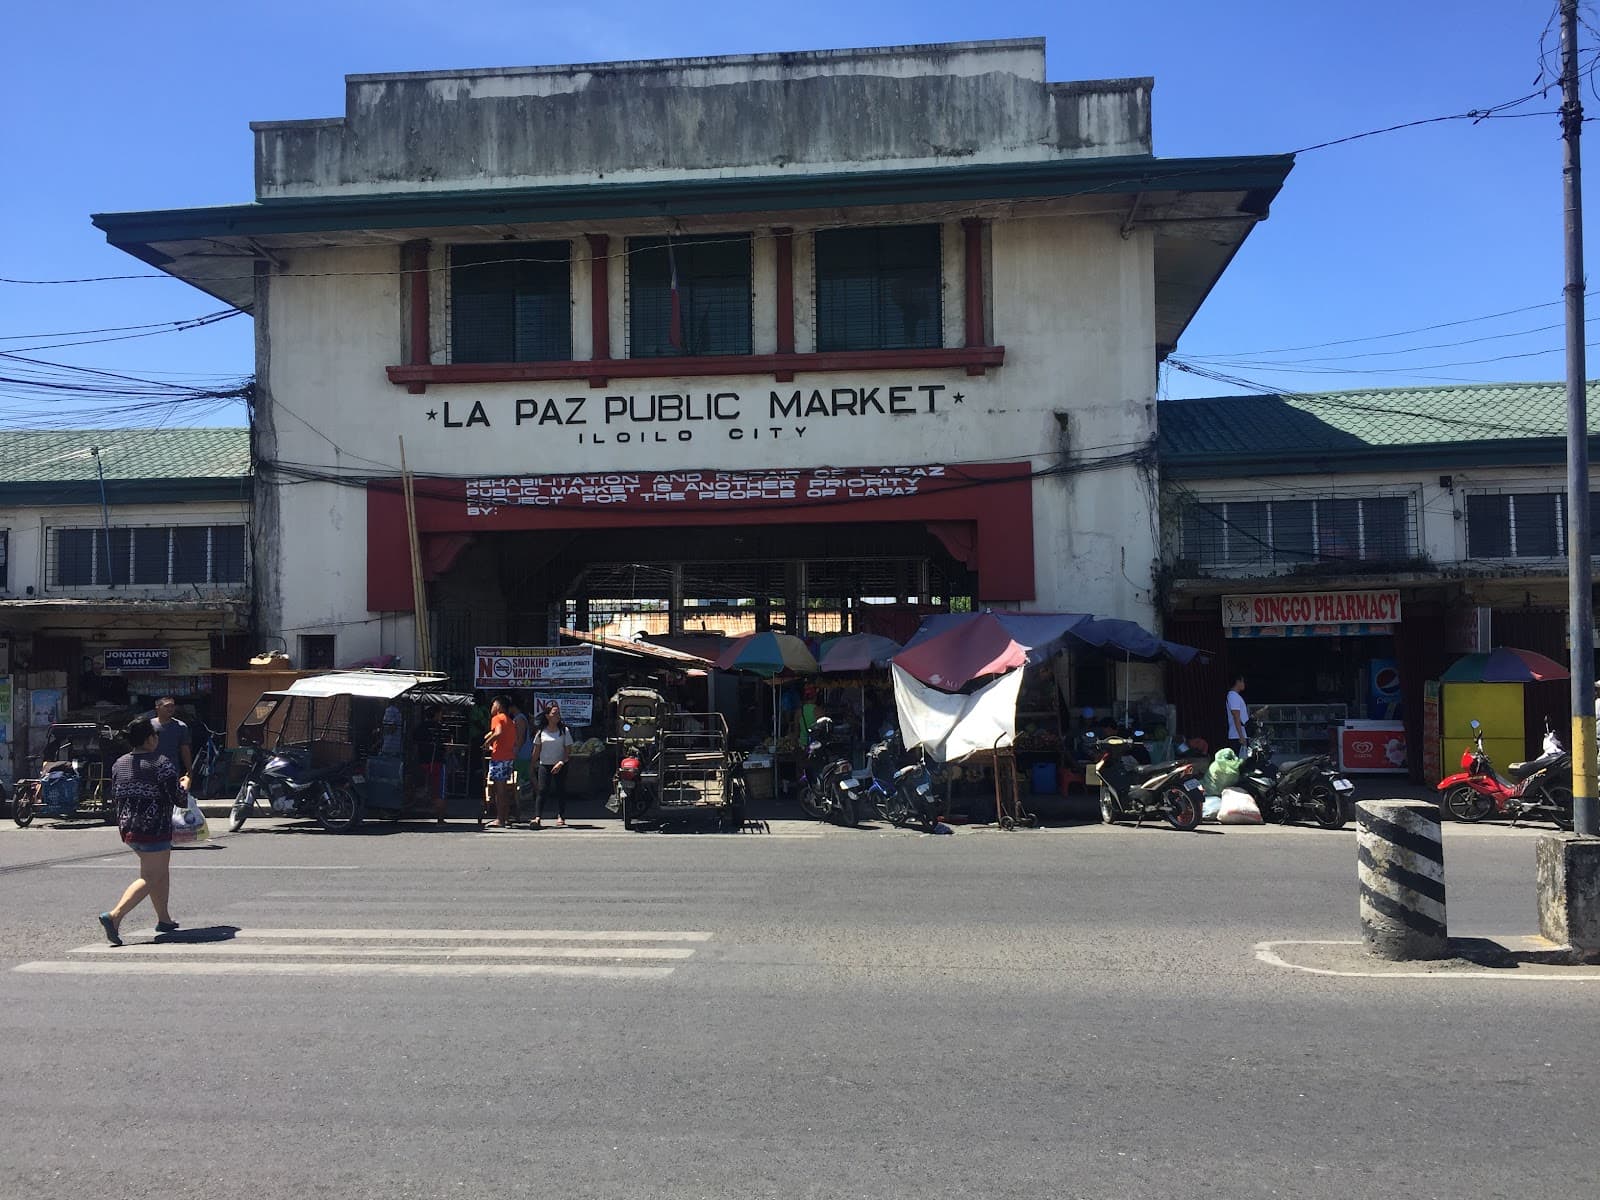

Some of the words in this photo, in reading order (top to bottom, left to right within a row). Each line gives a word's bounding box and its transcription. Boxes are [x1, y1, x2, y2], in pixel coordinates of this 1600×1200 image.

[443, 400, 491, 428] LA
[515, 398, 587, 425] PAZ
[605, 393, 740, 424] PUBLIC
[769, 384, 946, 419] MARKET
[578, 429, 693, 444] ILOILO
[728, 426, 807, 440] CITY
[466, 474, 640, 489] REHABILITATION
[653, 472, 702, 484] AND
[715, 469, 801, 481] REPAIR
[813, 468, 847, 479] OF
[466, 487, 539, 497] PUBLIC
[552, 484, 640, 495] MARKET
[652, 483, 673, 493] IS
[684, 479, 796, 492] ANOTHER
[808, 477, 922, 489] PRIORITY
[581, 493, 629, 504] FOR
[639, 491, 686, 503] THE
[698, 488, 796, 501] PEOPLE
[806, 488, 837, 498] OF
[848, 486, 919, 498] LAPAZ
[466, 506, 498, 517] BY:
[1254, 596, 1312, 623] SINGGO
[1314, 591, 1399, 622] PHARMACY
[106, 651, 168, 659] JONATHAN'S
[512, 657, 550, 669] SMOKING
[512, 668, 542, 679] VAPING
